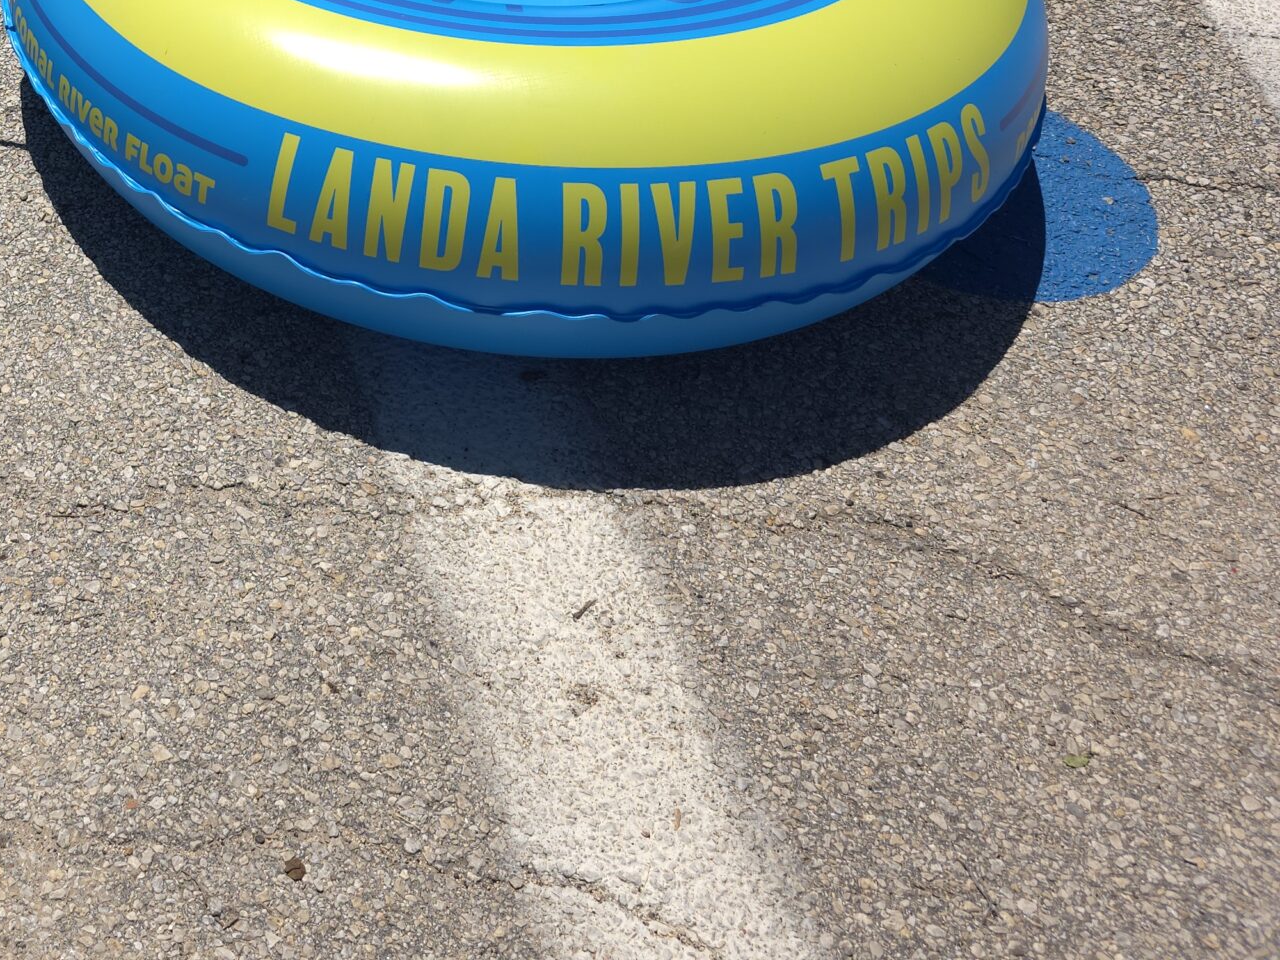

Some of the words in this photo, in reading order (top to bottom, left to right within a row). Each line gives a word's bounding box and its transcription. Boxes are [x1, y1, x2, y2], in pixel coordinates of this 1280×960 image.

[266, 132, 519, 281] LANDA
[560, 171, 798, 287] RIVER
[820, 103, 991, 263] TRIPS
